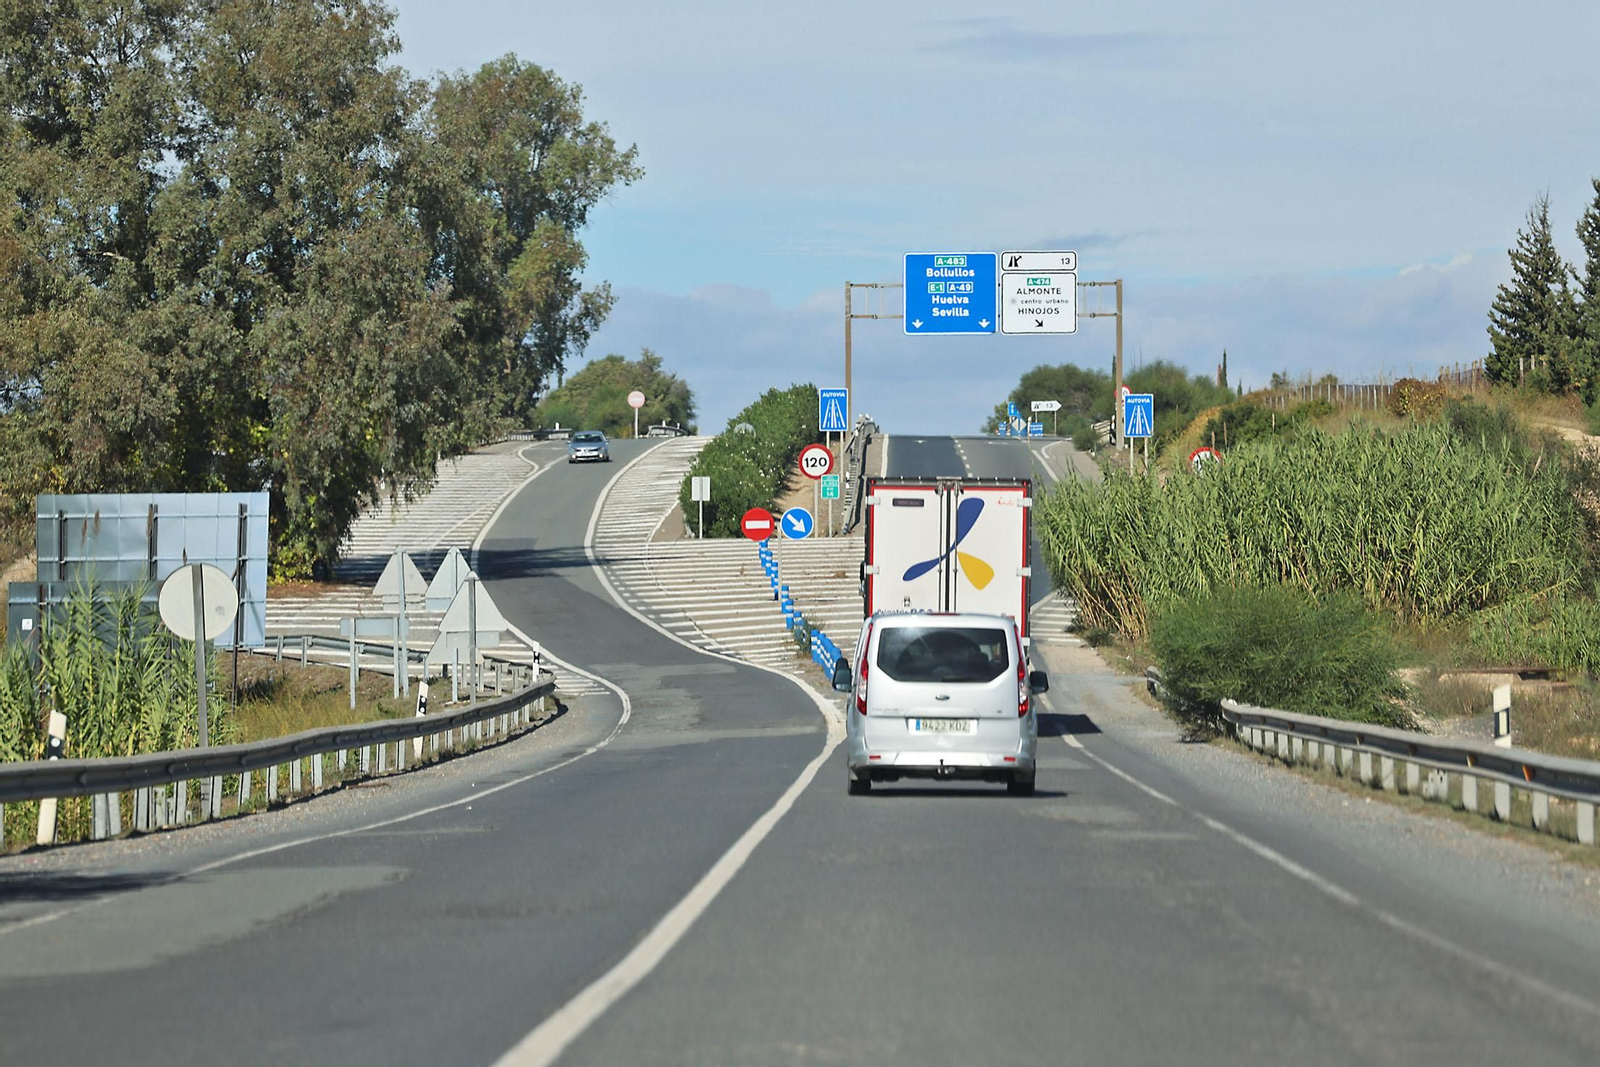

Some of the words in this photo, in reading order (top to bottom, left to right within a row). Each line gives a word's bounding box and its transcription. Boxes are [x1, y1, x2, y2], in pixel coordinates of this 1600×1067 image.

[937, 257, 965, 265] A-483
[1061, 257, 1071, 265] 13
[926, 268, 975, 277] Bollullos
[932, 295, 969, 304] Huelva
[932, 307, 970, 317] Sevilla
[1018, 307, 1060, 315] HINOJOS
[804, 457, 828, 468] 120
